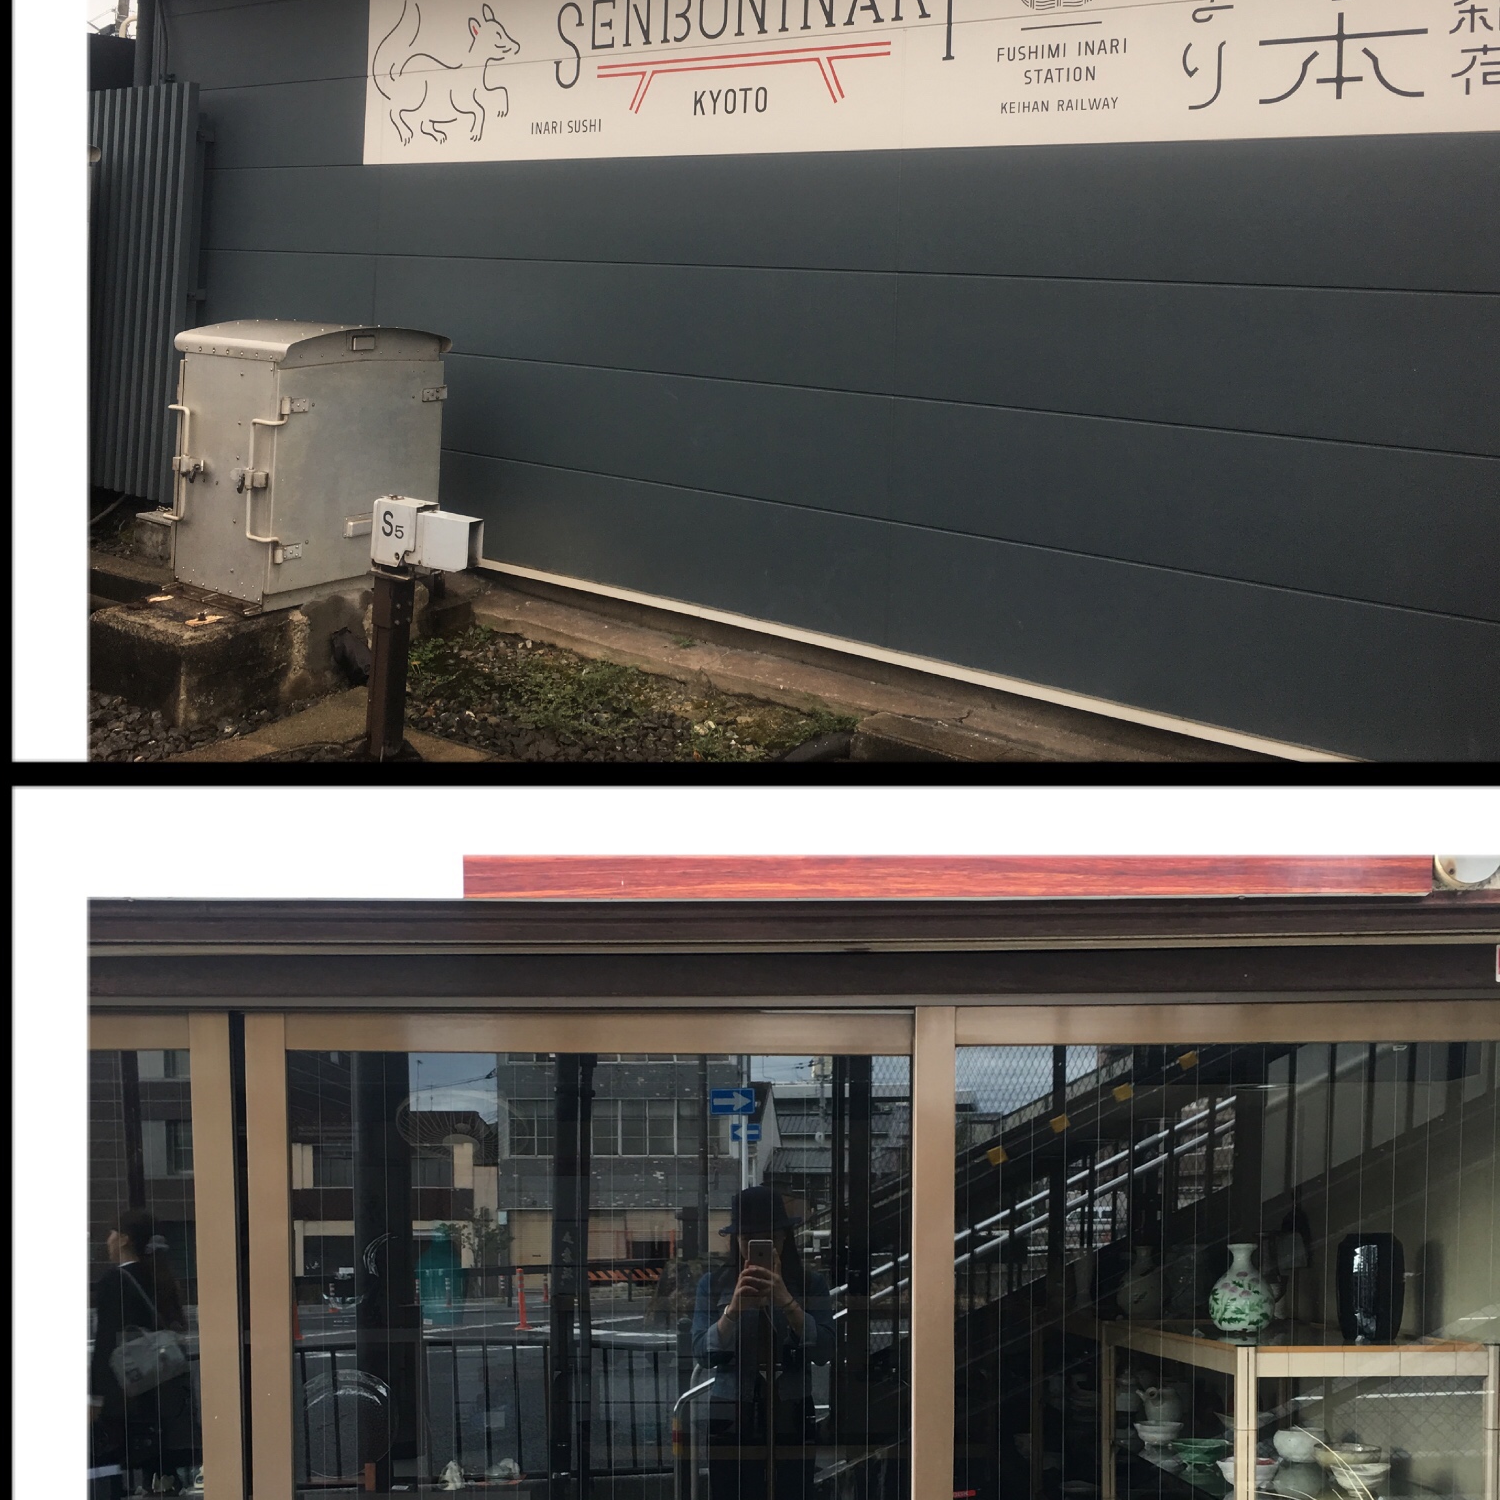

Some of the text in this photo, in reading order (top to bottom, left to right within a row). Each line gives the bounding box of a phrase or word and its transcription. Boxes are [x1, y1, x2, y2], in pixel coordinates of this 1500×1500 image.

[997, 37, 1128, 63] FUSHIMI INARI
[1023, 66, 1097, 85] STATION
[693, 86, 769, 116] KYOTO
[1000, 96, 1119, 115] KEIHAN RAILWAY
[530, 118, 602, 135] INARI SUSHI
